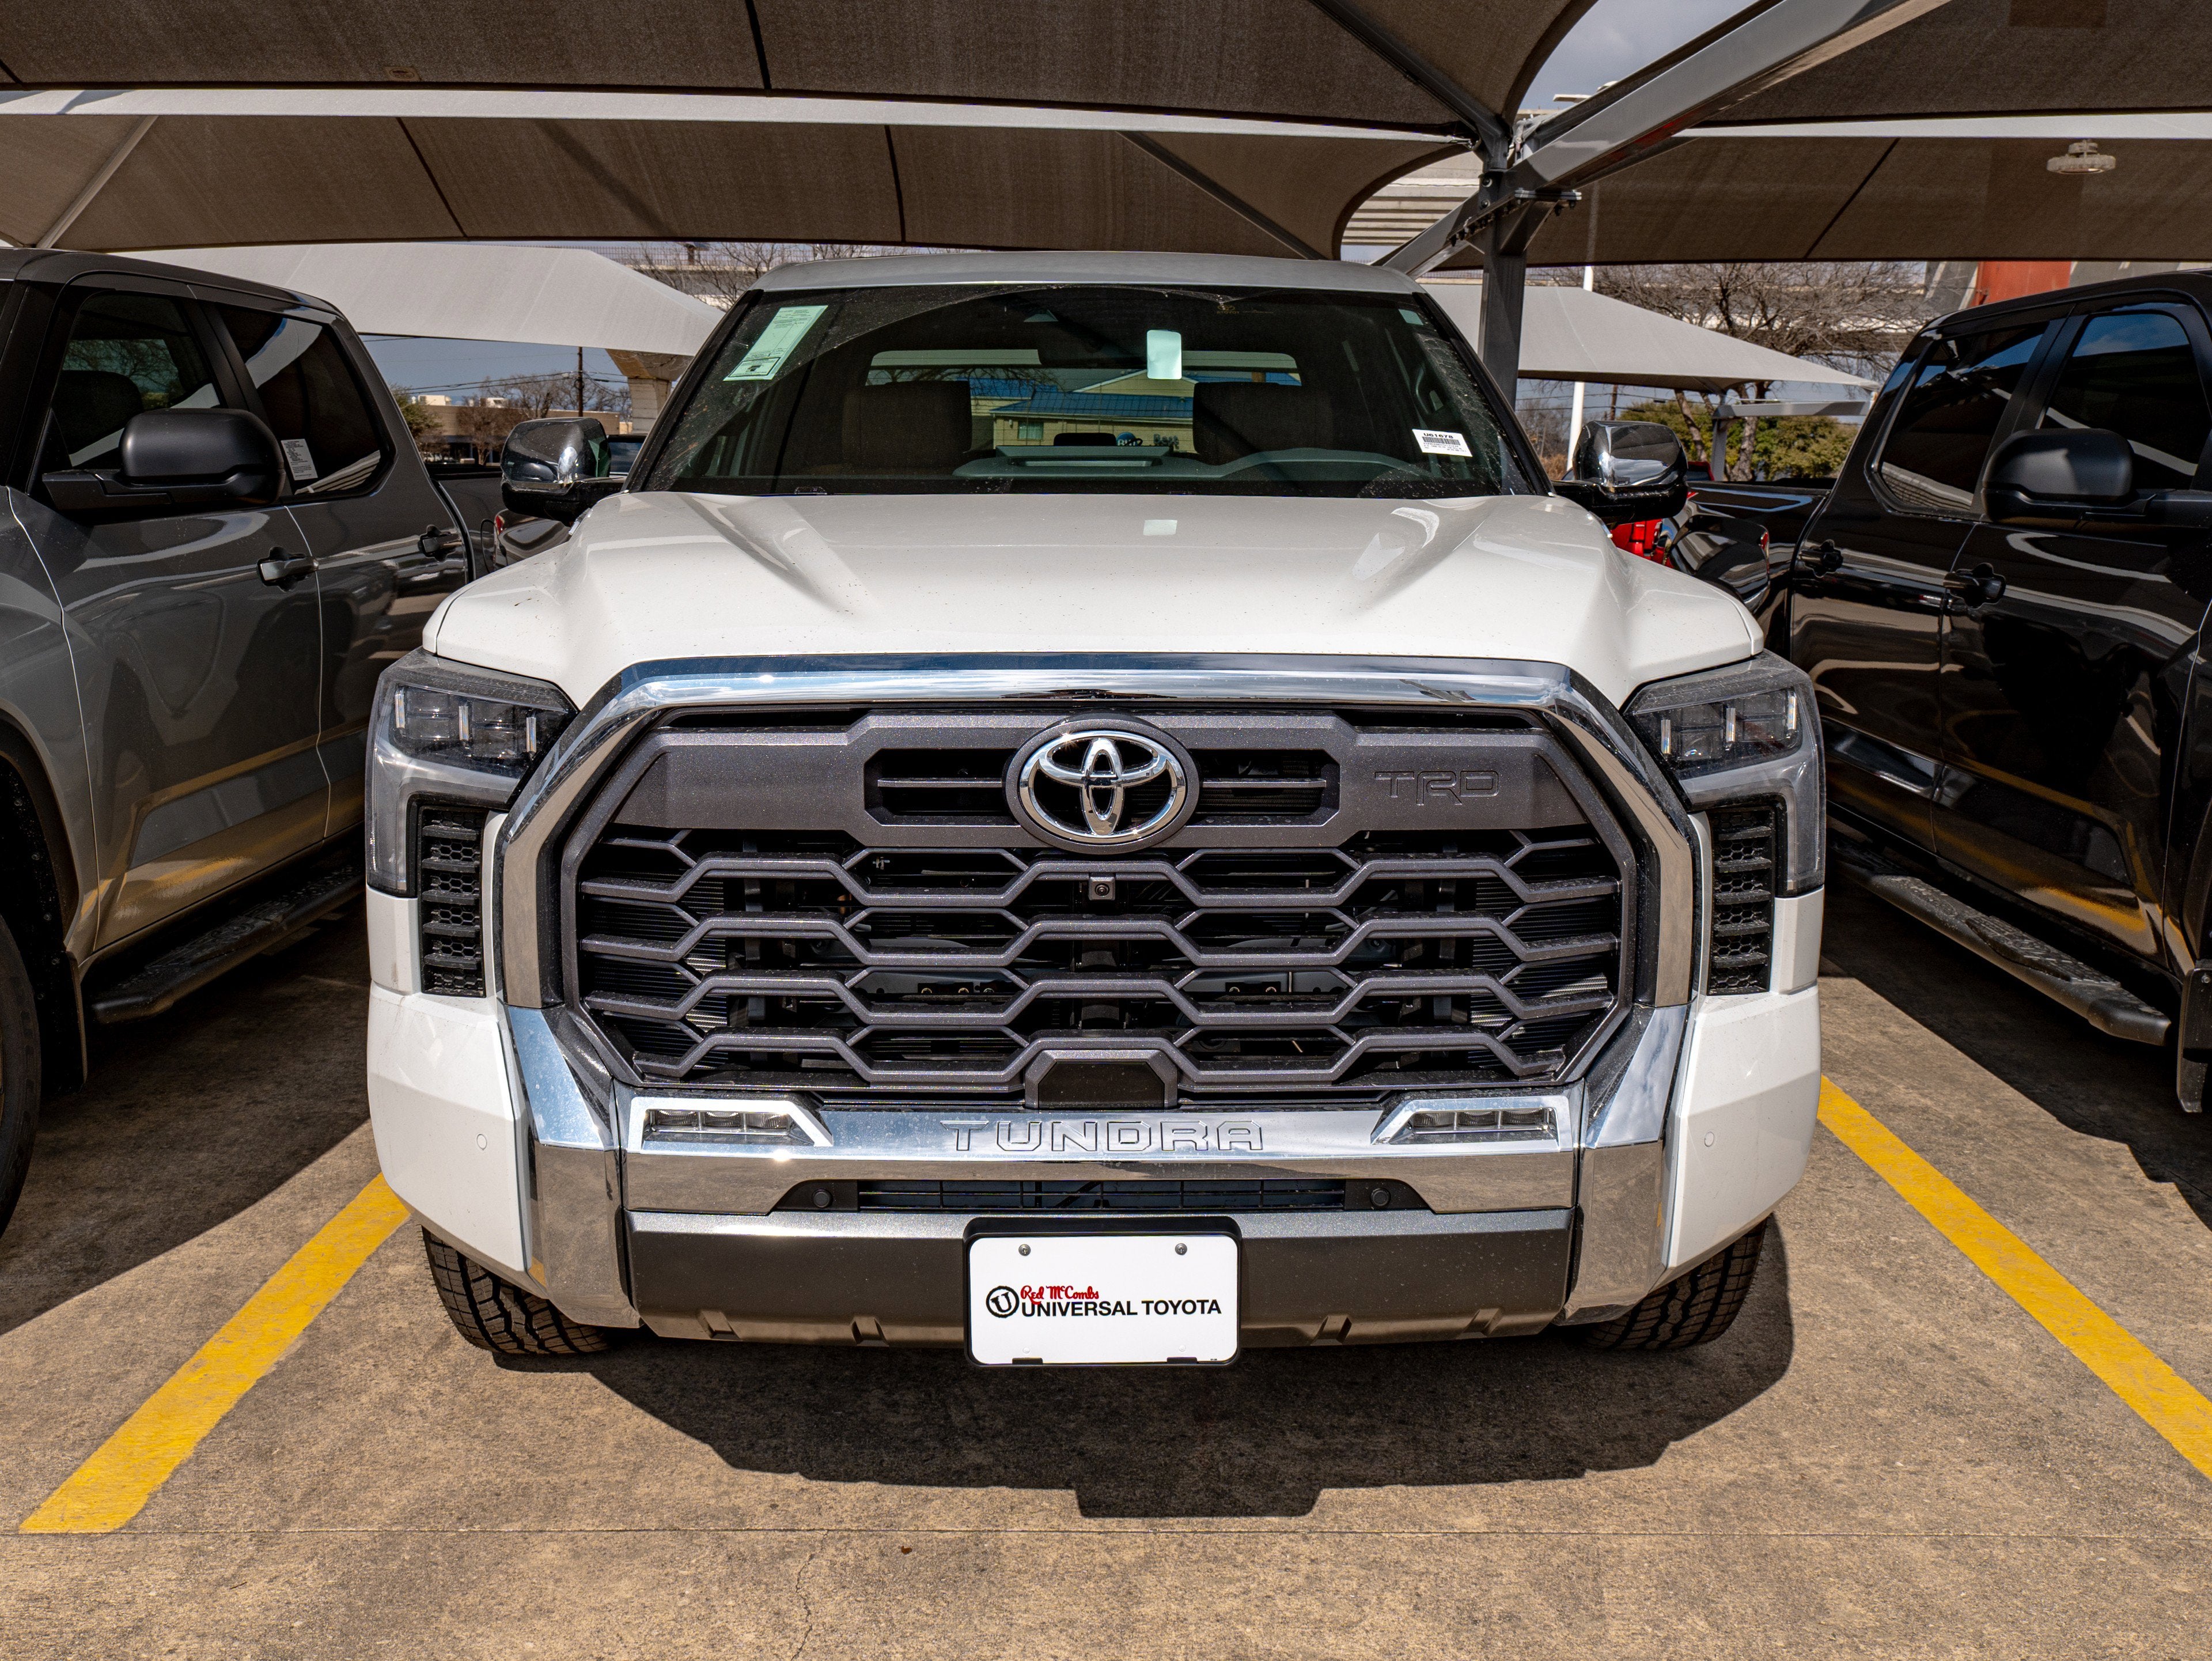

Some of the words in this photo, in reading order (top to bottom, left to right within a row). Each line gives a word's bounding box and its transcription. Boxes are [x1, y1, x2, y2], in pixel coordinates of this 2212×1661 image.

[1374, 771, 1499, 805] TRD
[940, 1121, 1263, 1152] TUNDRA
[1021, 1285, 1044, 1305] Red
[1046, 1285, 1099, 1300] McCombs
[1021, 1300, 1138, 1316] UNIVERSAL
[1141, 1299, 1222, 1315] TOYOTA
